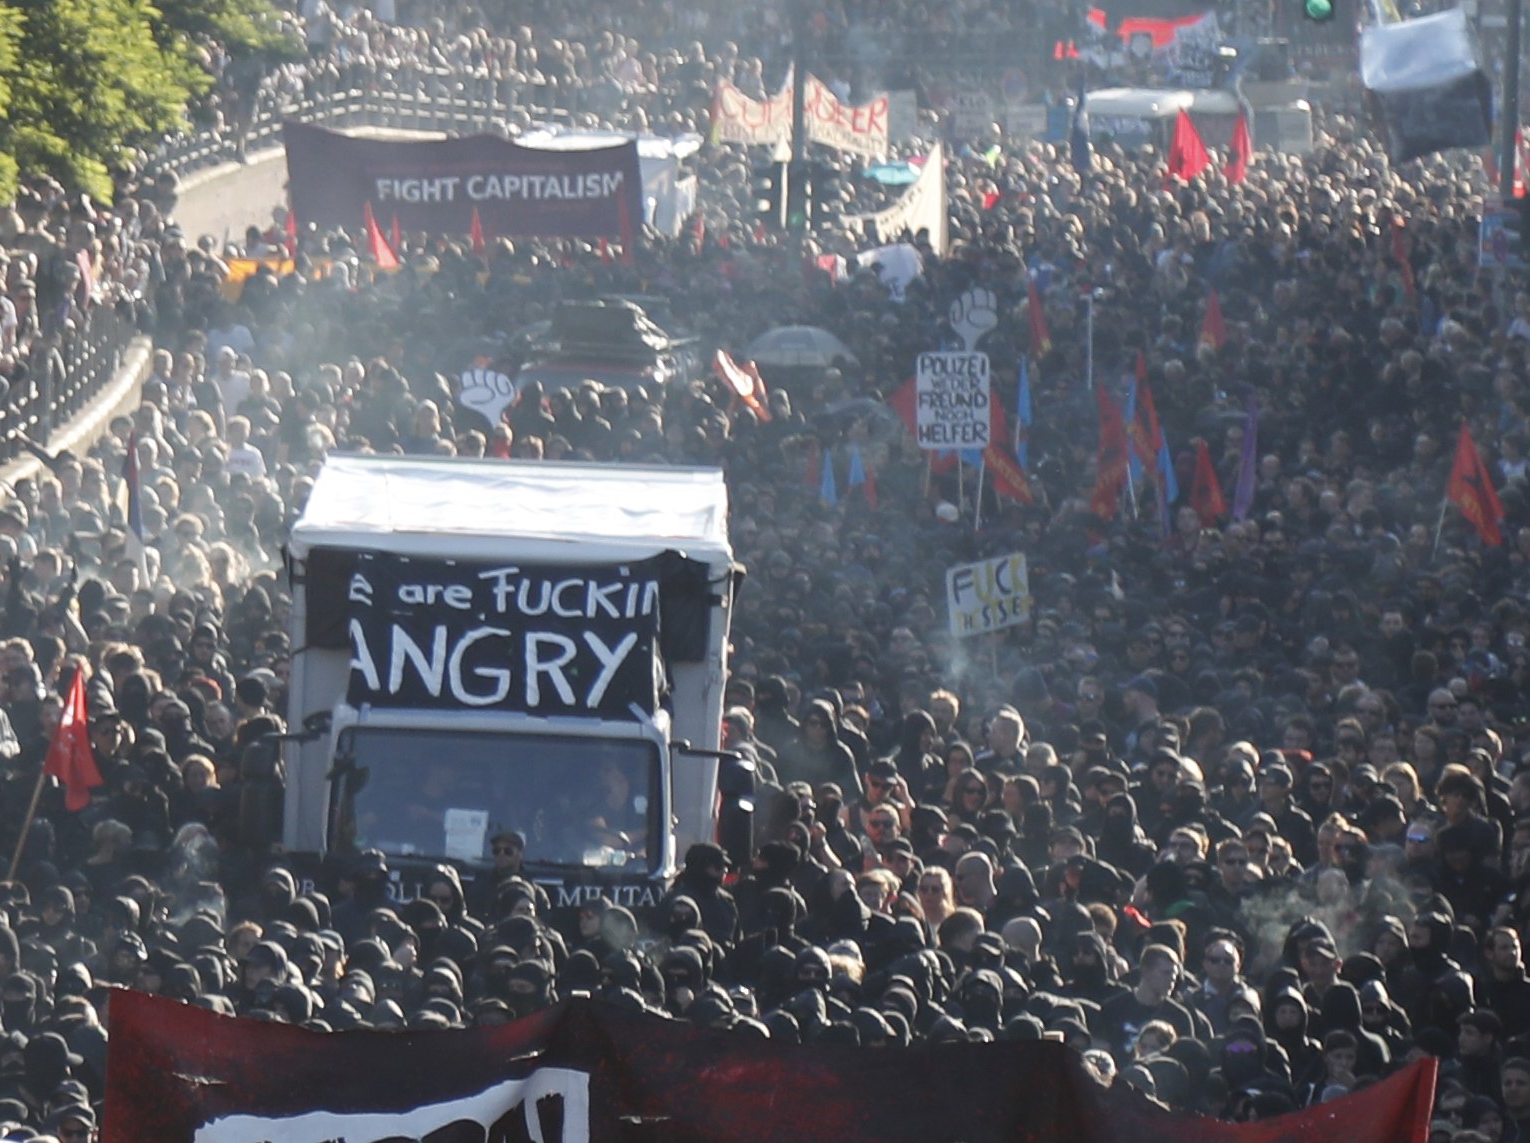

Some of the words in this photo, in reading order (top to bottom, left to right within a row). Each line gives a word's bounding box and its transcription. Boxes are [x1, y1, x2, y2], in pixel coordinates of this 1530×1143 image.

[376, 177, 460, 202] FIGHT
[466, 171, 624, 201] CAPITALISM
[921, 356, 987, 376] POLIZEI
[920, 391, 988, 409] FREUND
[920, 422, 988, 443] HELFER
[397, 582, 473, 610] are
[349, 617, 639, 708] ANGRY
